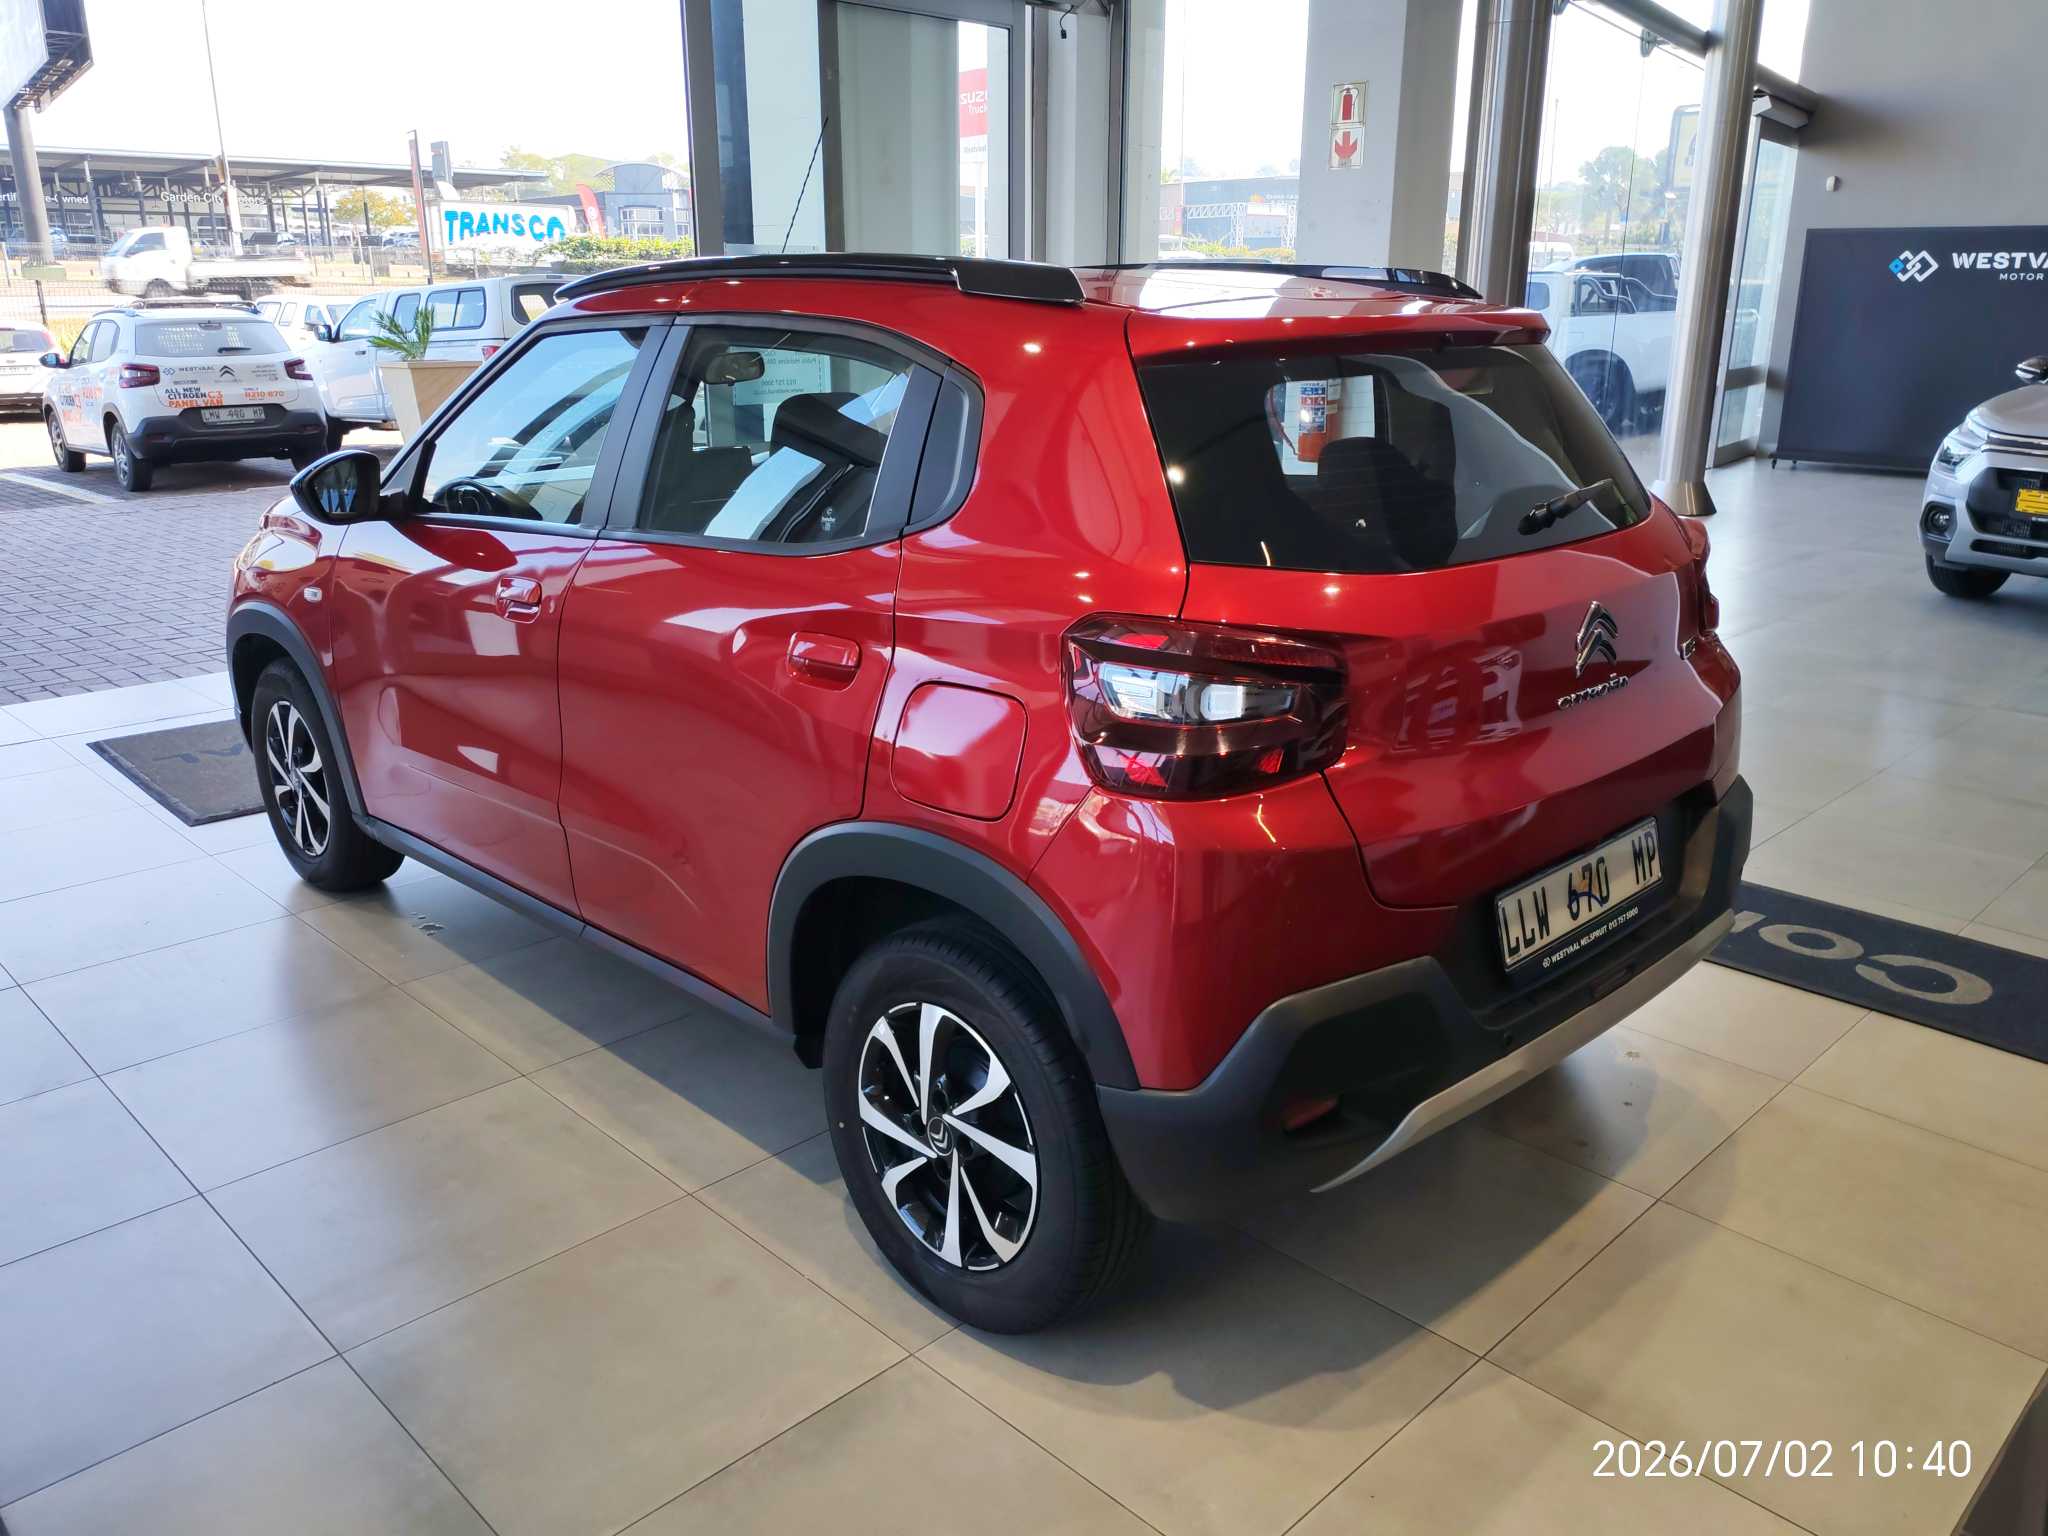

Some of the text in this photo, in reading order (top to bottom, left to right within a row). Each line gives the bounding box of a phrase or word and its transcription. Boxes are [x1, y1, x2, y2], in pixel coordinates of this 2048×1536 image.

[160, 191, 201, 203] Garden
[207, 390, 223, 399] C3
[168, 399, 224, 408] PANEL VAN
[1502, 831, 1656, 958] LLW 670 MP
[1551, 943, 1581, 964] WESTVAAL
[1625, 906, 1639, 921] 5000
